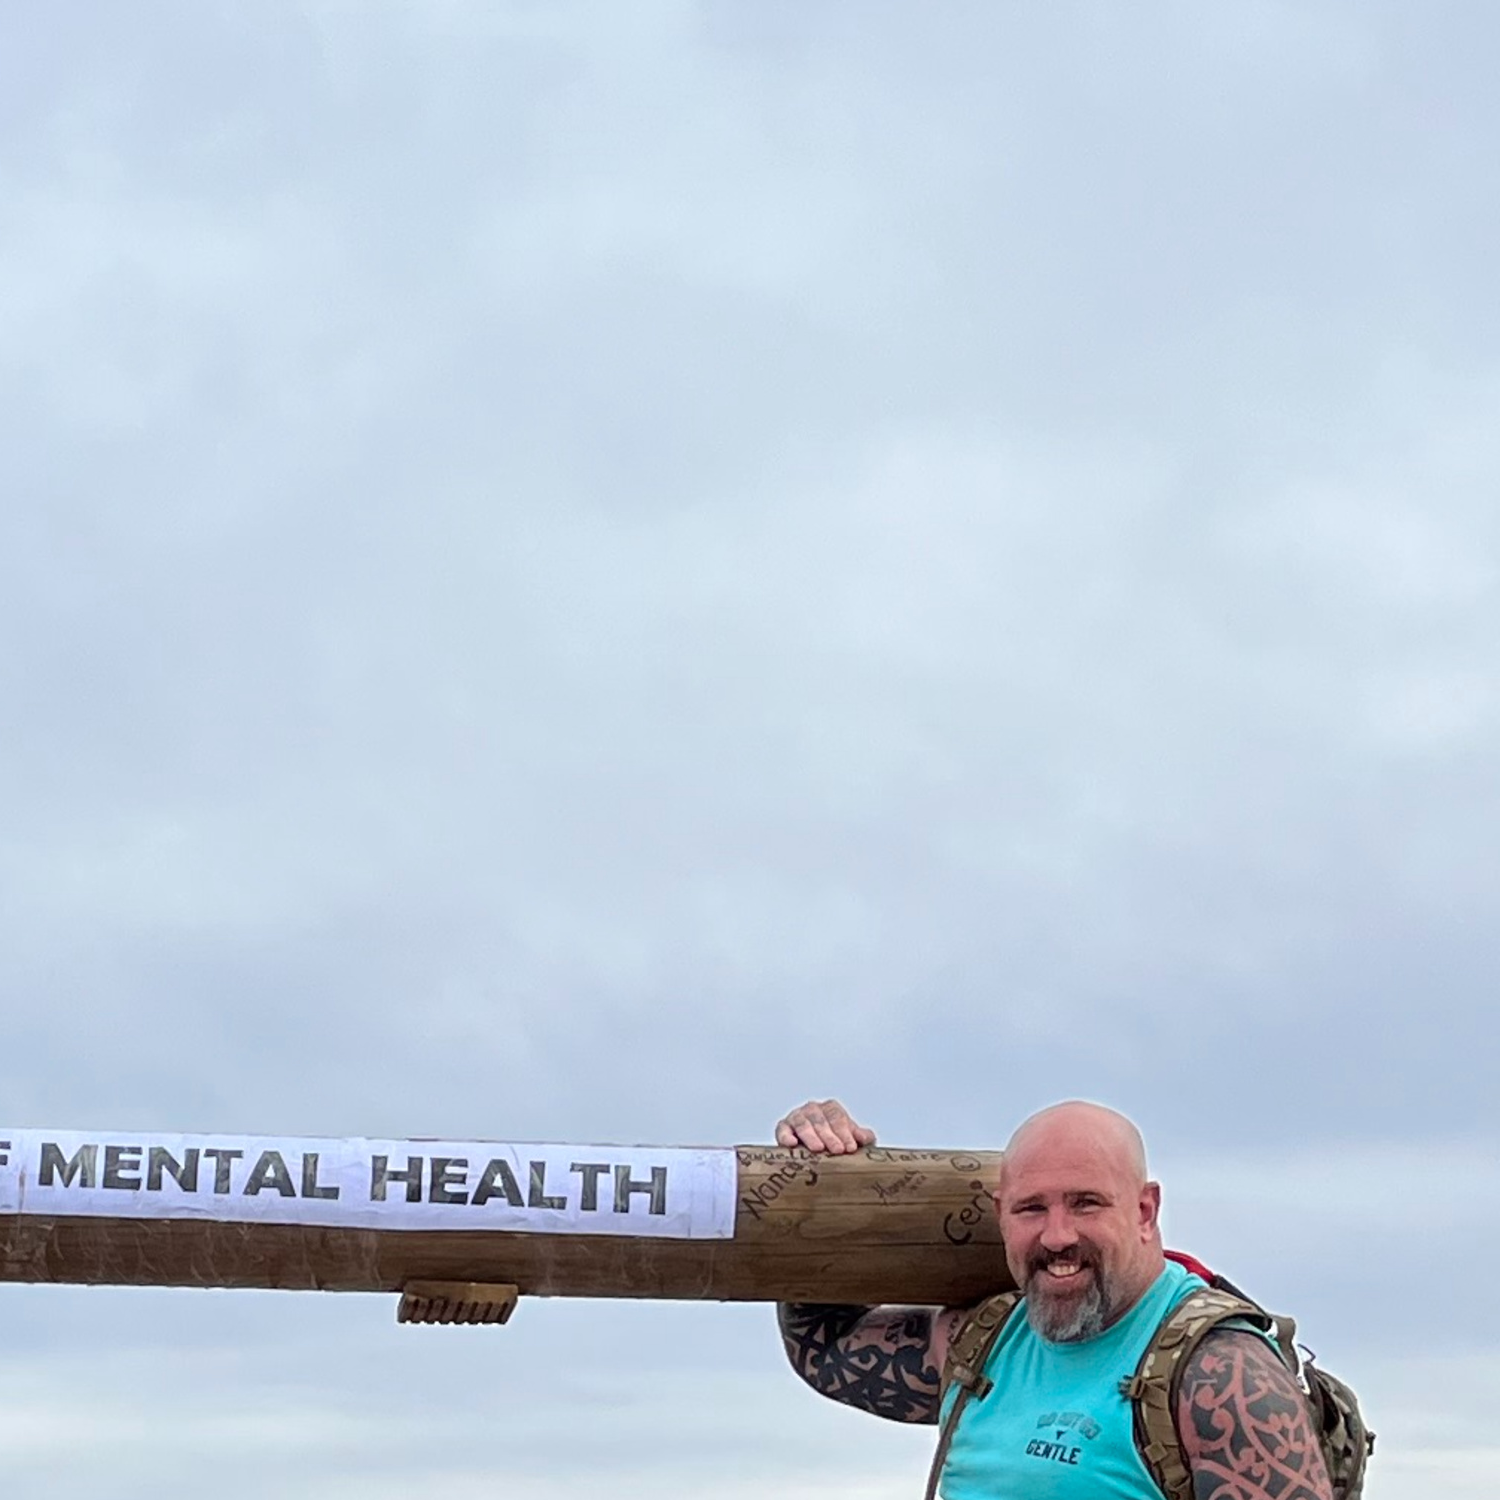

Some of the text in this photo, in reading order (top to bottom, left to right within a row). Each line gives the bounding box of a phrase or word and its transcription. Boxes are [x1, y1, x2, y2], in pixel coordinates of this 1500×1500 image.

[37, 1142, 340, 1201] MENTAL
[370, 1154, 668, 1216] HEALTH
[741, 1158, 818, 1220] Nancy
[943, 1180, 995, 1245] Ceri
[1026, 1439, 1081, 1465] GENTLE
